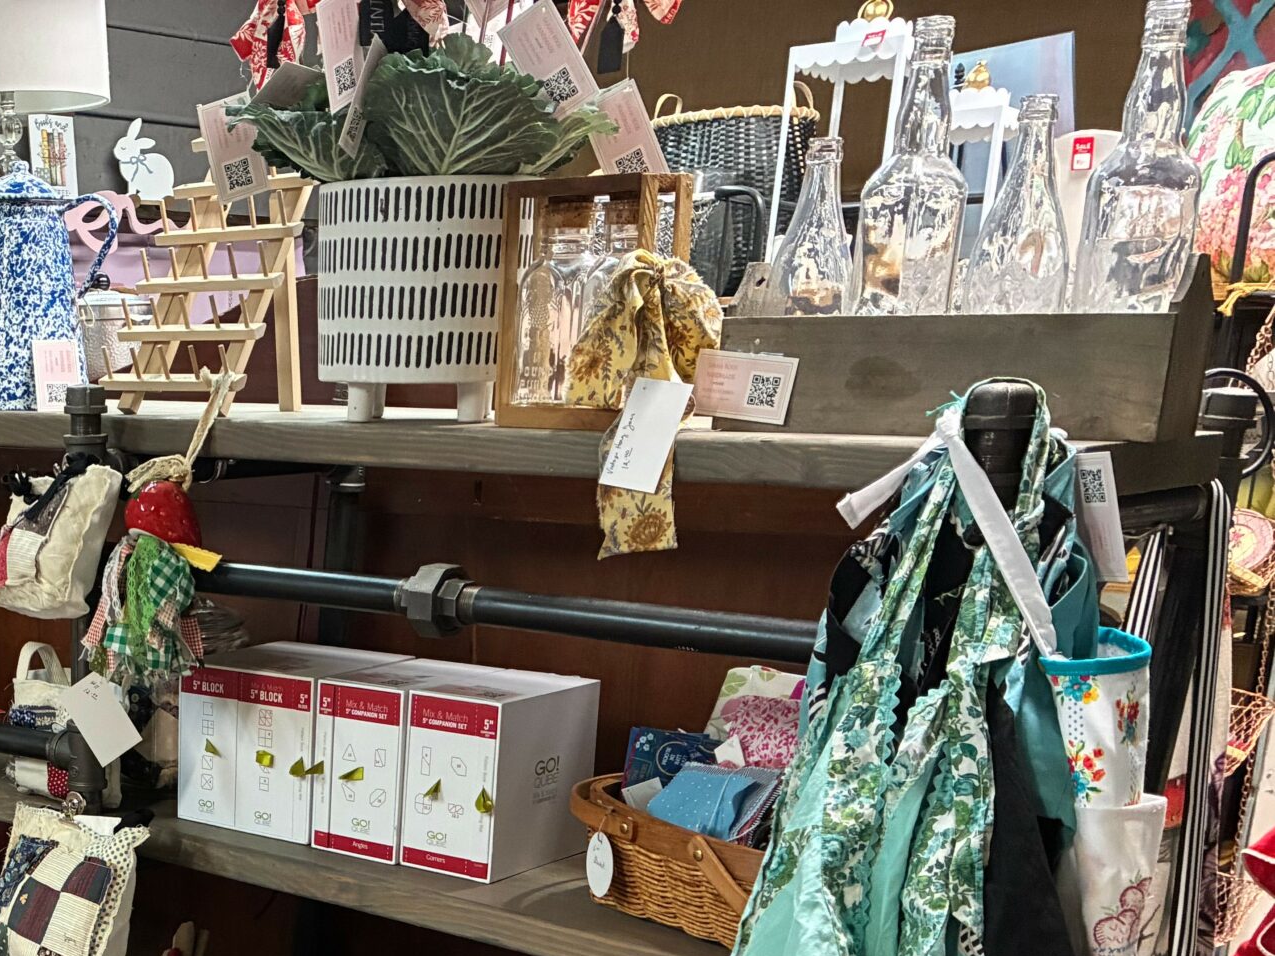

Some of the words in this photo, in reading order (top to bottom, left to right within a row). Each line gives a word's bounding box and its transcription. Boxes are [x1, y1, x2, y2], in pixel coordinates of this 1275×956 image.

[192, 680, 201, 691] 5"
[201, 681, 225, 695] BLOCK
[250, 689, 259, 700] 5"
[259, 690, 283, 704] BLOCK
[299, 693, 308, 704] 5"
[322, 697, 331, 707] 5"
[345, 699, 357, 708] Mix
[358, 701, 365, 709] &
[366, 701, 389, 713] Match
[351, 709, 378, 719] COMPANION
[378, 712, 388, 720] SET
[422, 708, 435, 718] Mix
[436, 711, 444, 719] &
[445, 711, 469, 723] Match
[428, 718, 457, 729] COMPANION
[457, 722, 468, 730] SET
[483, 719, 494, 731] 5"
[535, 755, 560, 776] GO!
[198, 799, 215, 809] GO!
[254, 810, 272, 820] GO!
[351, 817, 371, 828] GO!
[427, 830, 447, 842] GO!
[352, 841, 369, 850] Angles
[426, 853, 446, 864] Corners
